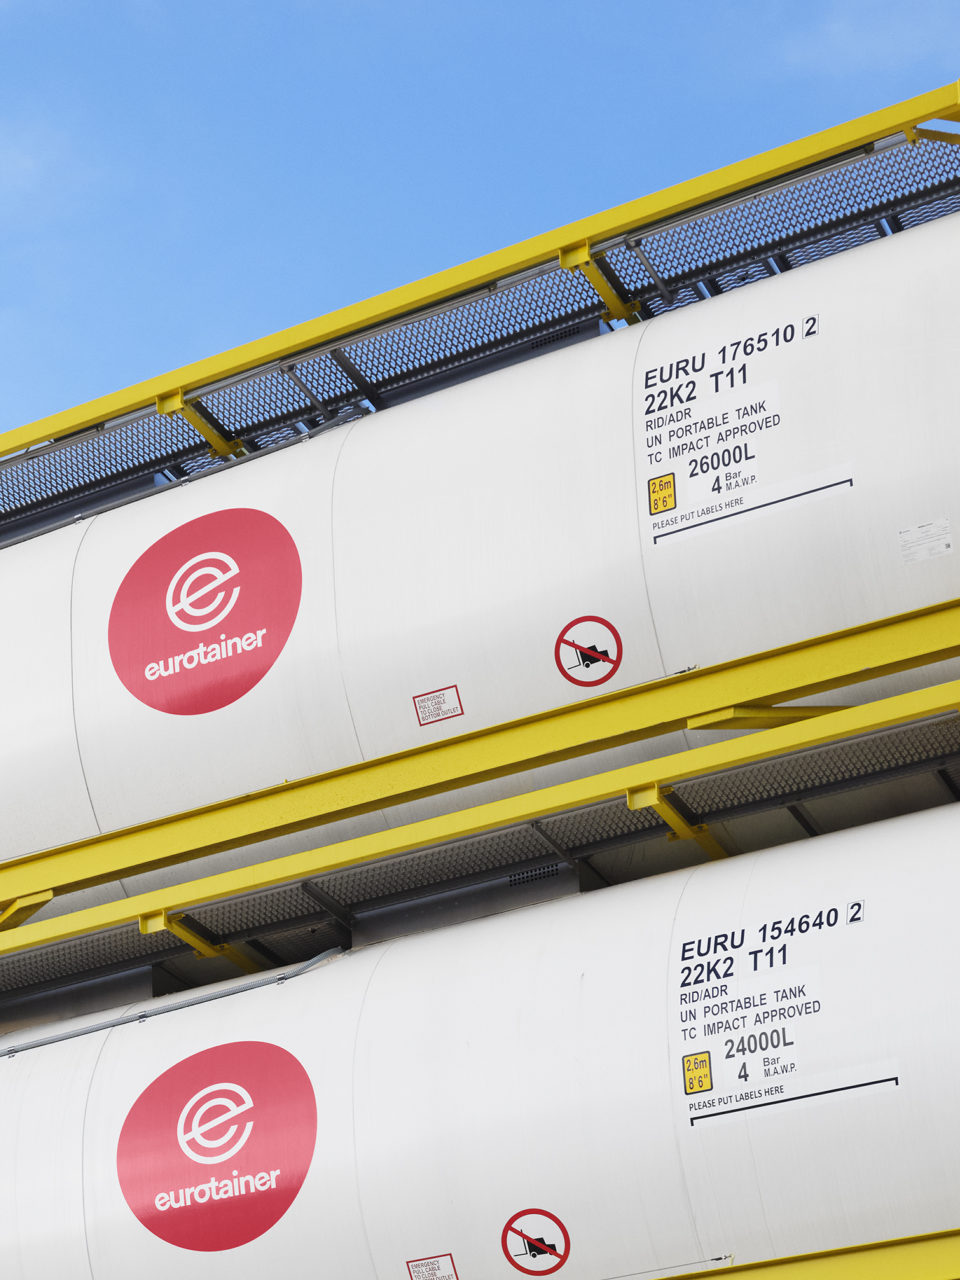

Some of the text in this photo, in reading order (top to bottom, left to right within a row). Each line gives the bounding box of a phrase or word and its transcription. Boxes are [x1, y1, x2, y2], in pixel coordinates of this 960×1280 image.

[644, 317, 817, 389] EURU 176510 2
[644, 364, 748, 415] 22K2 T11
[646, 408, 692, 431] RID/ADR
[646, 400, 766, 448] UN PORTABLE TANK
[648, 414, 780, 465] TC IMPACT APPROVED
[689, 443, 755, 478] 26000L
[725, 470, 741, 481] Bar
[712, 476, 723, 494] 4
[652, 498, 744, 530] PLEASE PUT LABELS HERE
[144, 628, 267, 682] eurotainer
[681, 903, 862, 961] EURU 154640 2
[680, 944, 787, 988] 22K2 T11
[680, 984, 728, 1005] RID/ADR
[680, 985, 806, 1023] UN PORTABLE TANK
[682, 1000, 820, 1041] TC IMPACT APPROVED
[724, 1027, 794, 1059] 24000L
[738, 1062, 749, 1082] 4
[763, 1056, 780, 1067] Bar
[689, 1085, 784, 1111] PLEASE PUT LABELS HERE
[155, 1169, 280, 1211] eurotainer
